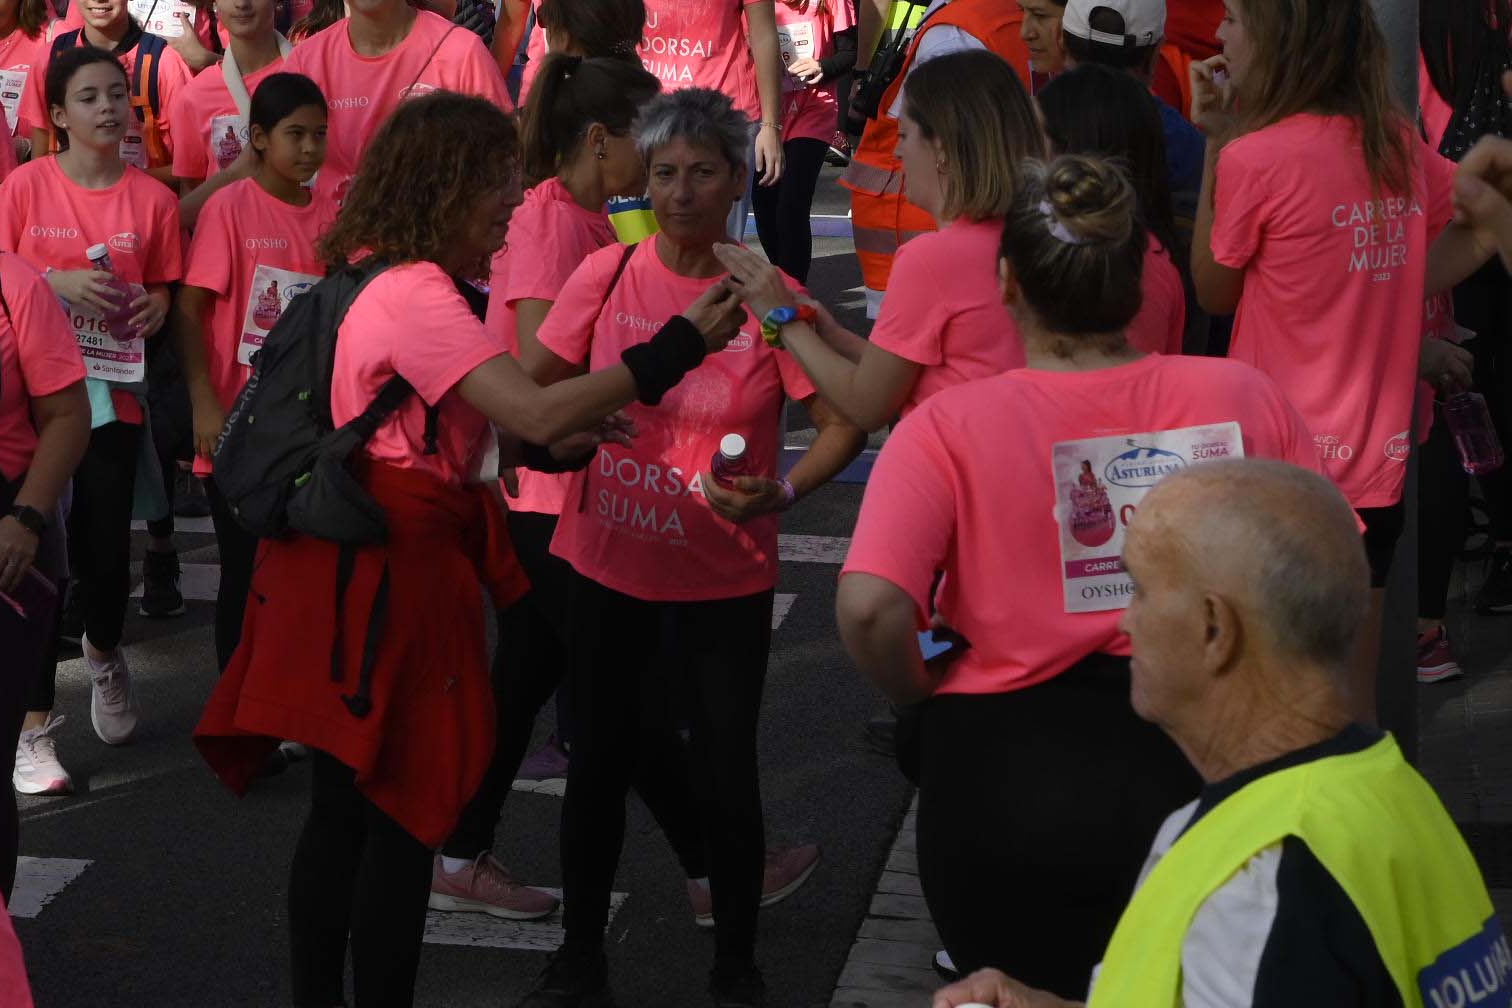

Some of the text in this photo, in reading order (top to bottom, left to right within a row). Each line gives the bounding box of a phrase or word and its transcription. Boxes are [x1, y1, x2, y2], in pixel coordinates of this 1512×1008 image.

[642, 59, 694, 82] SUMA
[328, 95, 370, 109] OYSHO
[1332, 196, 1424, 227] CARRERA
[30, 223, 78, 240] OYSHO
[1354, 223, 1405, 248] DE LA
[245, 237, 288, 250] OYSHO
[1348, 245, 1408, 273] MUJER
[73, 315, 109, 333] 016
[75, 334, 104, 346] 27481
[101, 364, 136, 375] Santander
[1191, 447, 1230, 461] SUMA
[597, 489, 685, 537] SUMA
[1084, 560, 1120, 573] CARRE
